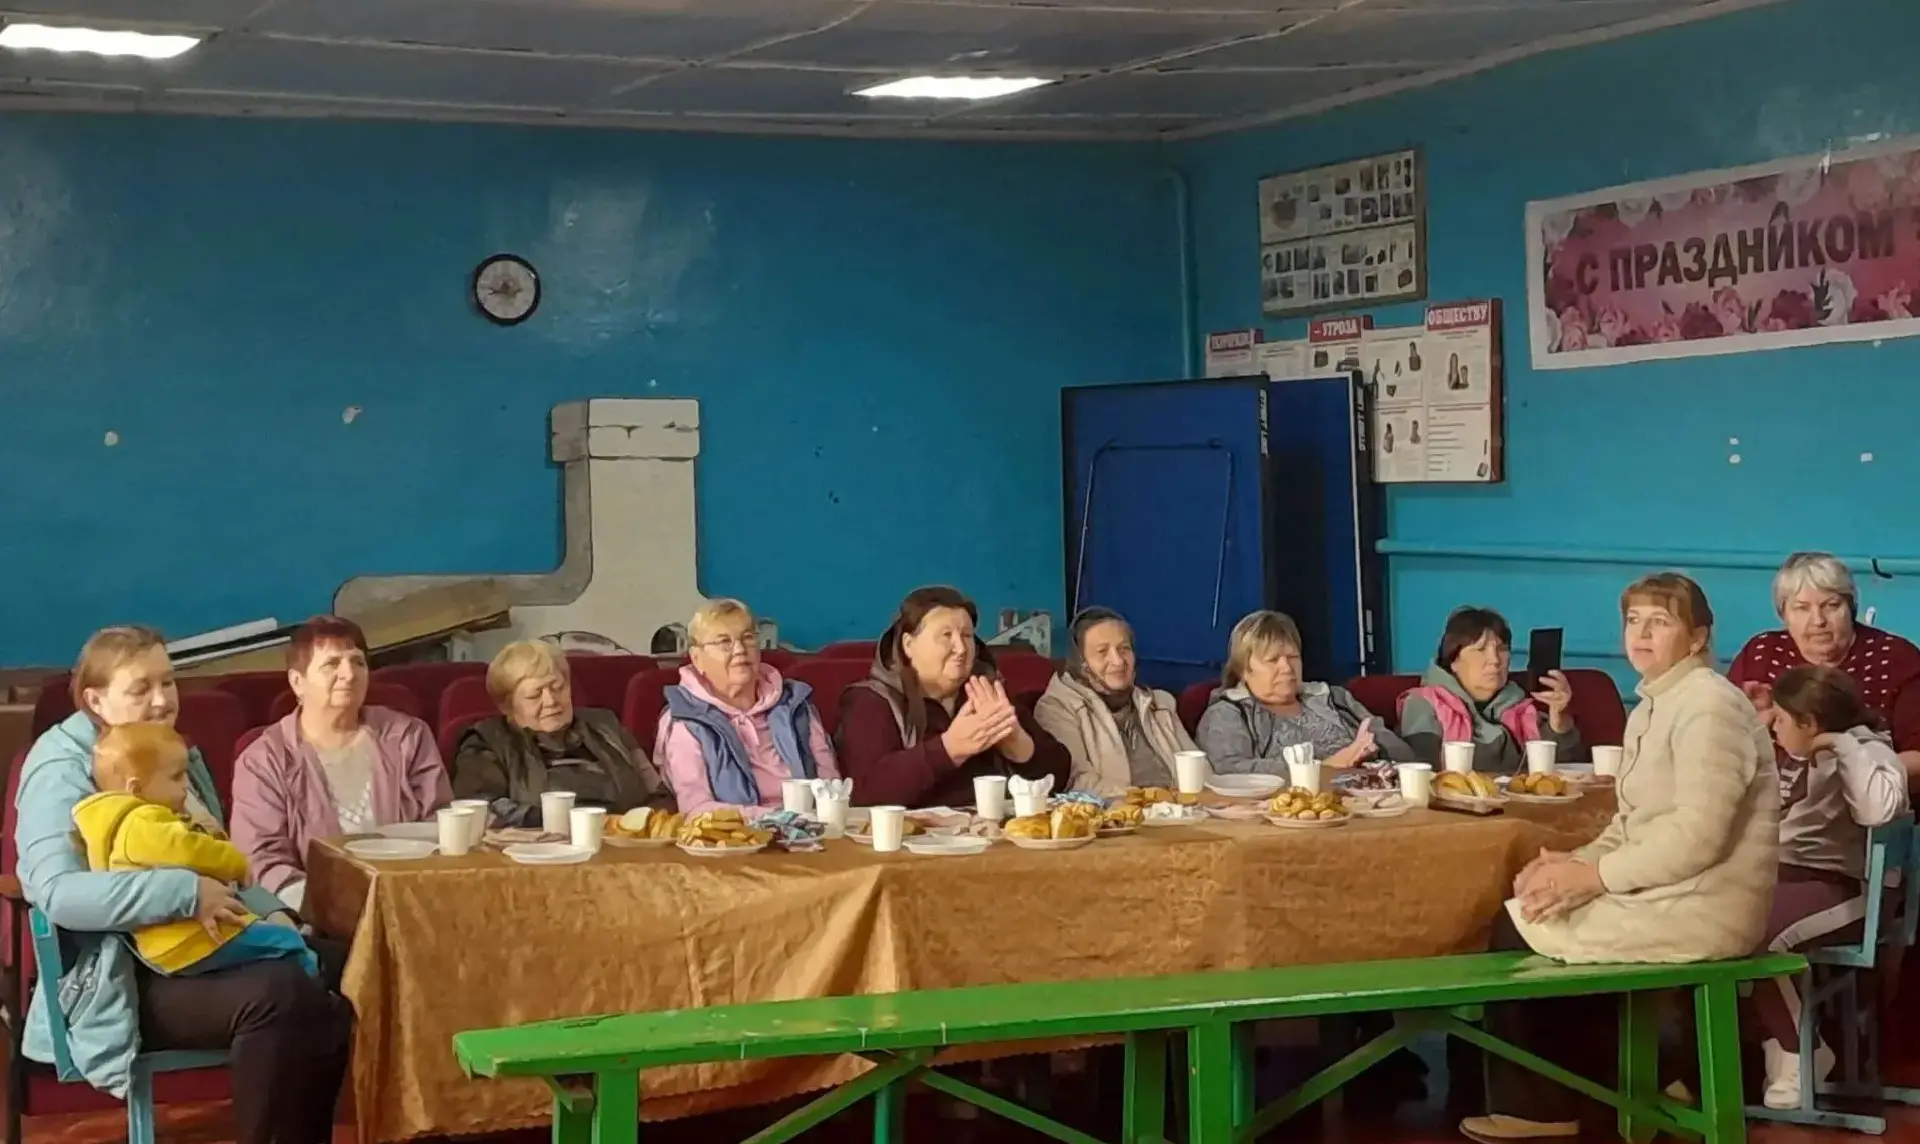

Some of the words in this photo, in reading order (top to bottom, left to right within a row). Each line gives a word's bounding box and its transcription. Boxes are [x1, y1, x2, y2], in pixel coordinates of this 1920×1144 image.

[1576, 250, 1599, 296] С
[1608, 209, 1895, 292] ПРАЗДНИКОМ
[1427, 302, 1488, 326] ОБЩЕСТВУ
